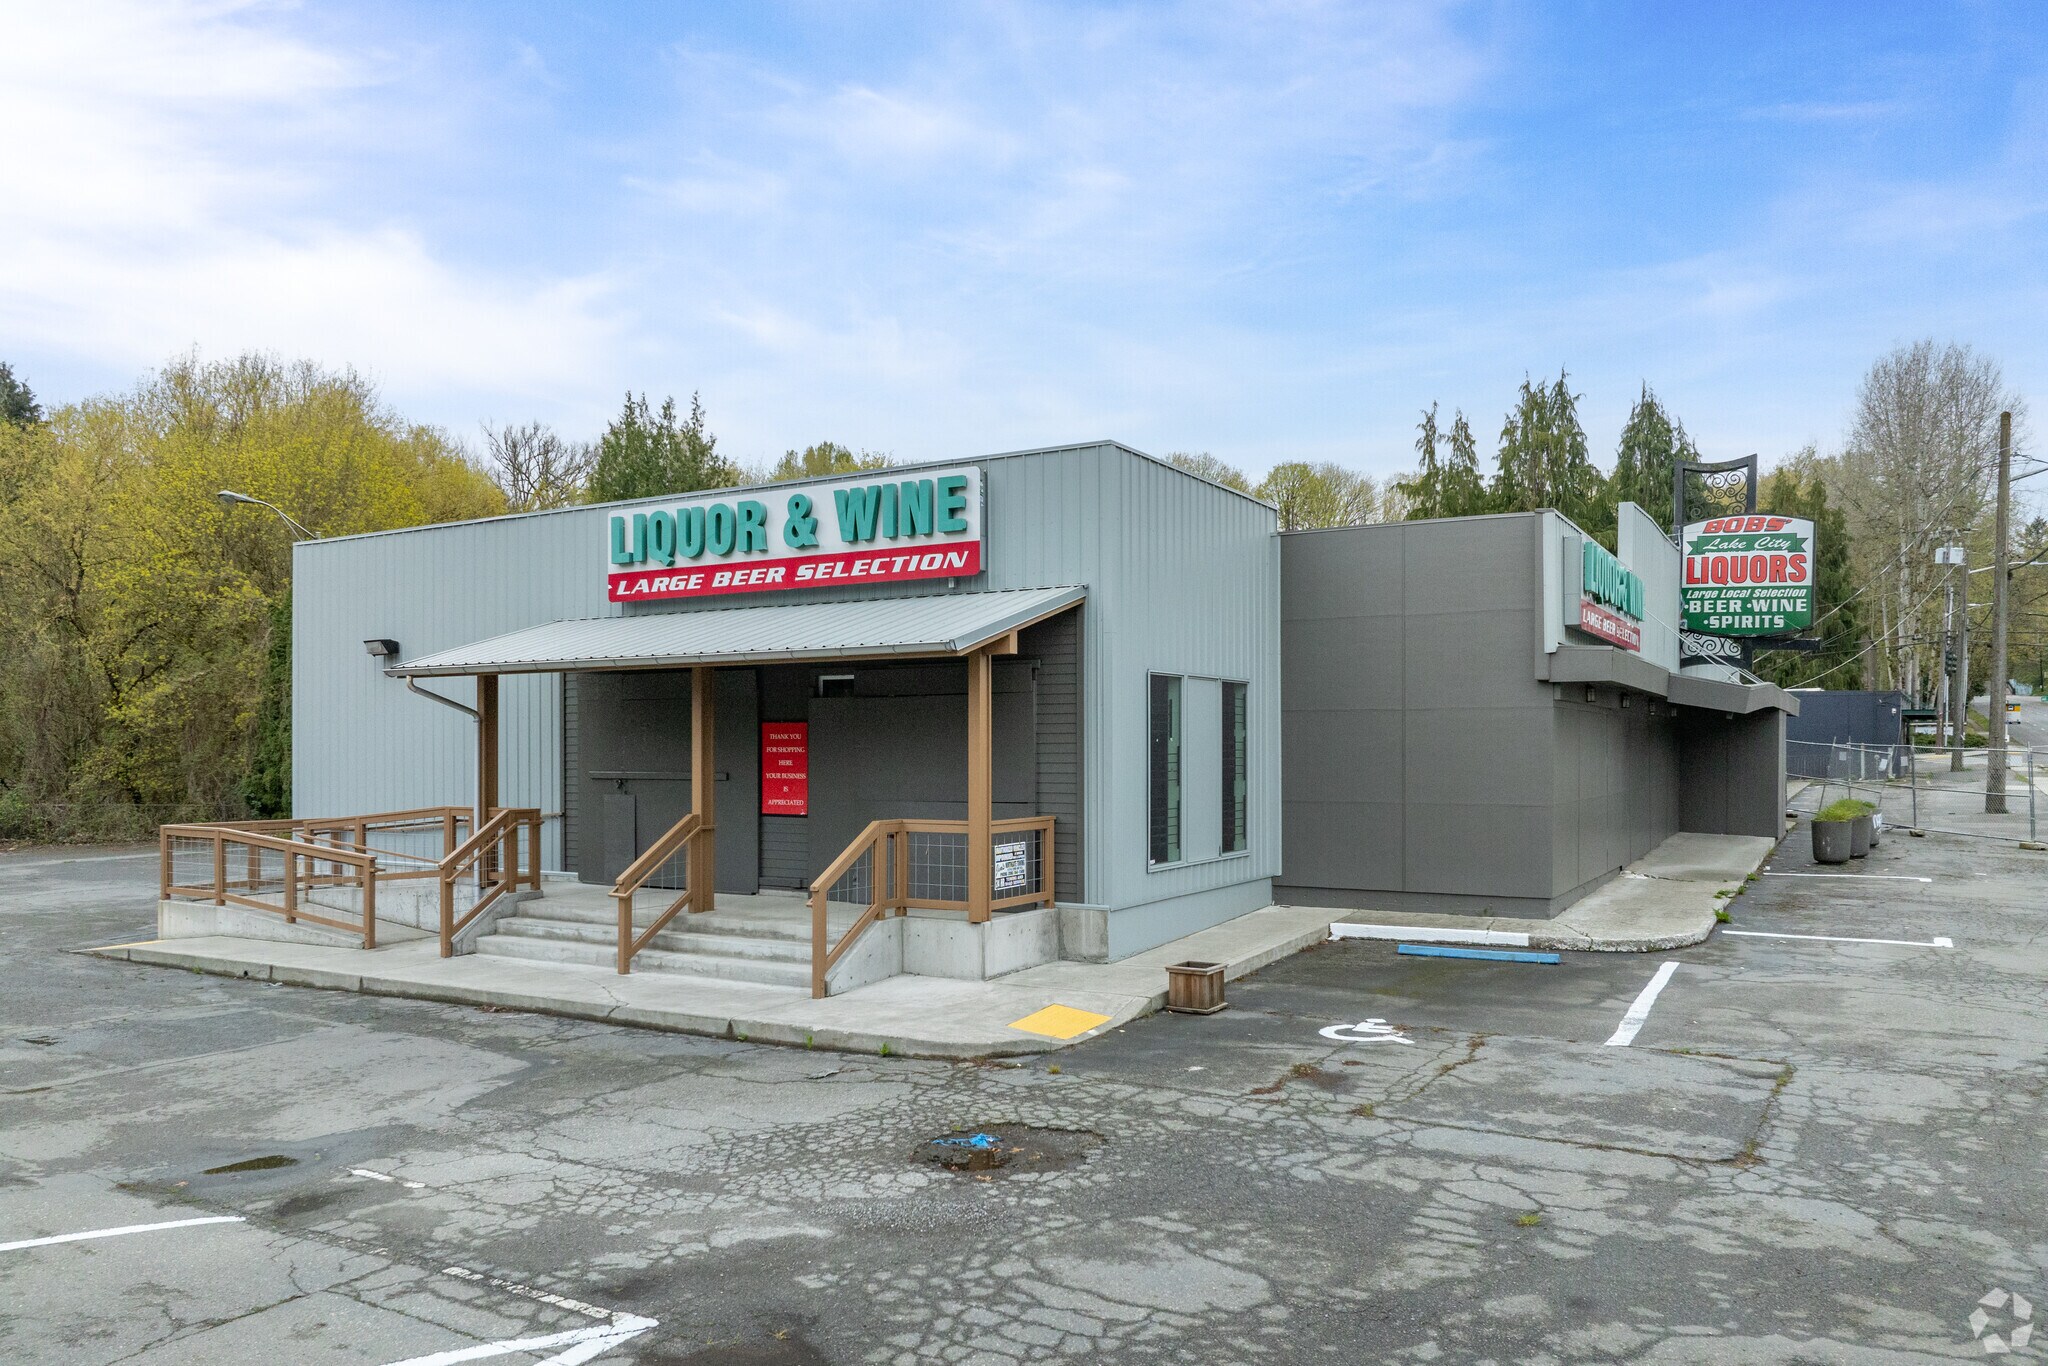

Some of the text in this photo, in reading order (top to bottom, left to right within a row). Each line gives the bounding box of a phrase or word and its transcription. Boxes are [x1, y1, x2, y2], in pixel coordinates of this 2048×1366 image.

[610, 474, 968, 567] LIQUOR & WINE
[1702, 536, 1792, 550] Lake City
[616, 550, 970, 596] LARGE BEER SELECTION
[1685, 553, 1807, 586] LIQUORS
[1686, 587, 1807, 600] Large Local Selection
[1582, 607, 1602, 630] LARGE
[1602, 617, 1616, 637] BEER
